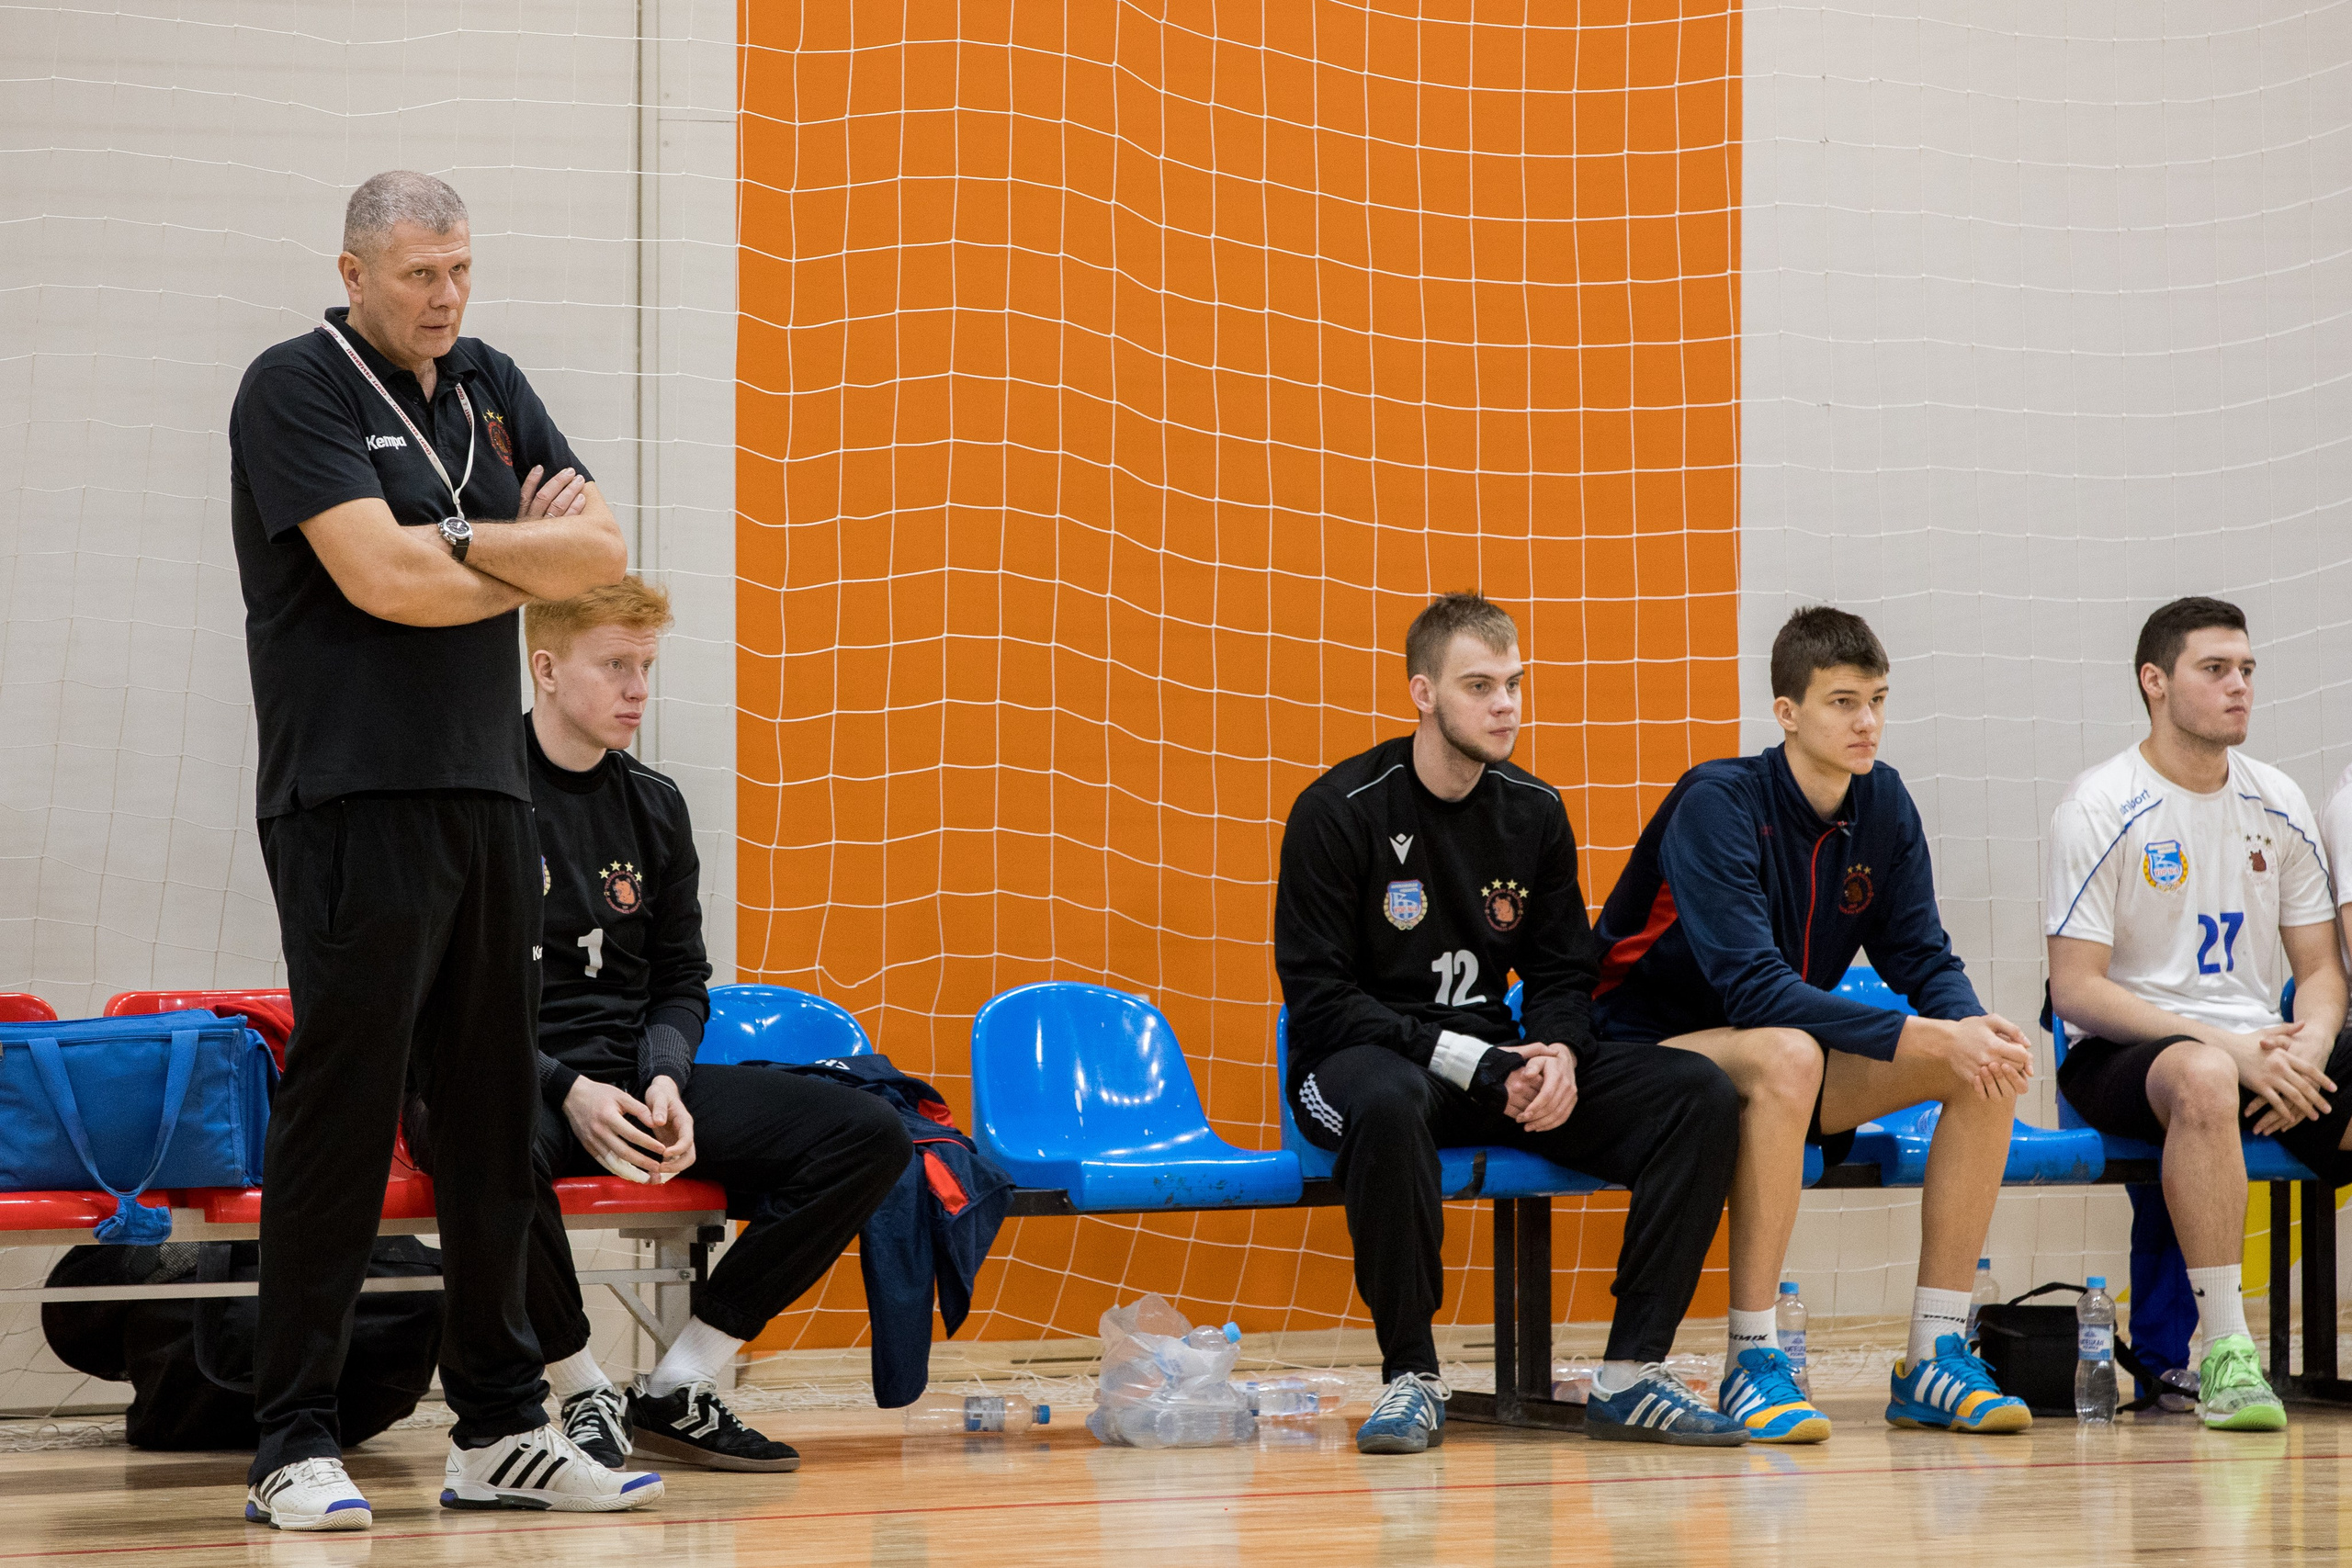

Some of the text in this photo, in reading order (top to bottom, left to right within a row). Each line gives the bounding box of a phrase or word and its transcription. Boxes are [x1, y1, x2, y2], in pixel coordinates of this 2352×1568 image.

[372, 380, 387, 396] СПОРТ
[366, 434, 407, 451] Kempa
[419, 438, 432, 456] СПОРТ
[577, 928, 604, 979] 1
[2197, 911, 2244, 975] 27
[1431, 949, 1487, 1007] 12
